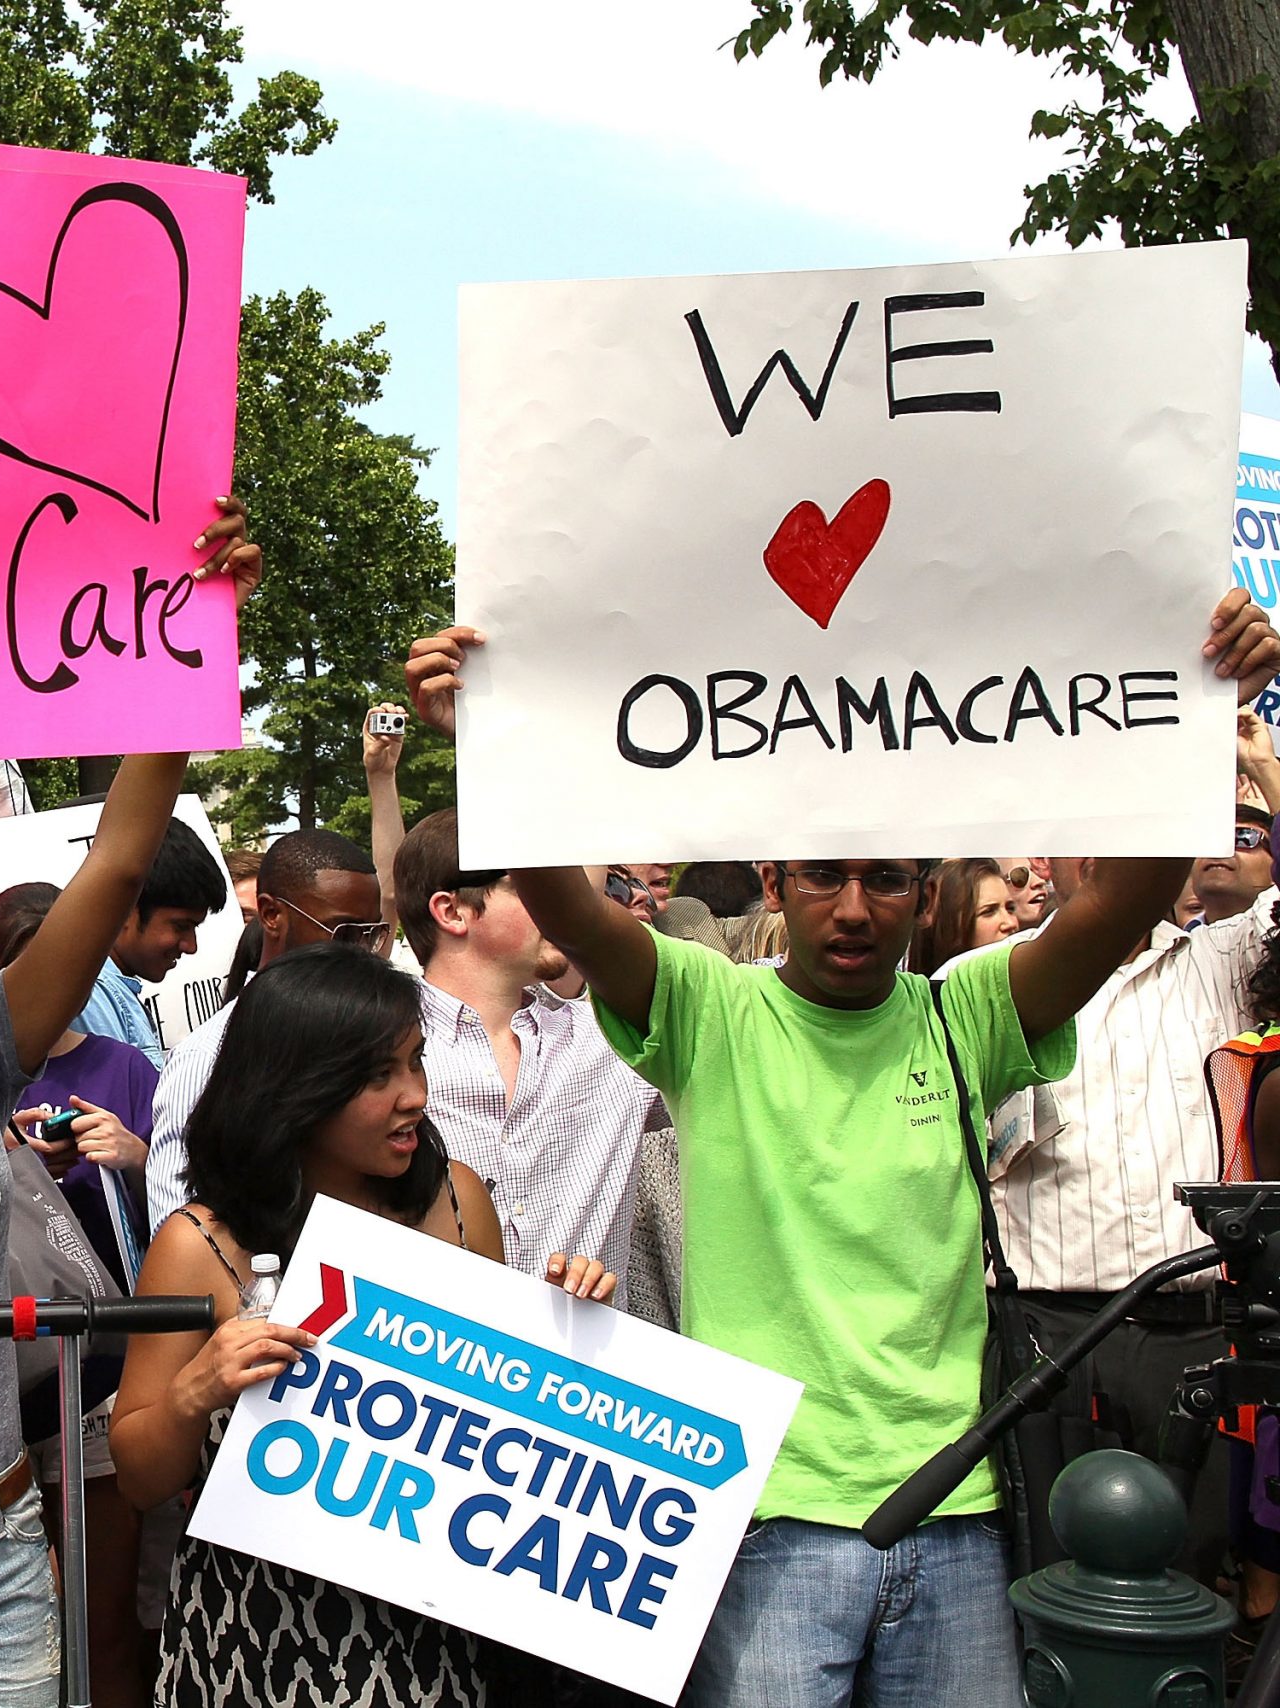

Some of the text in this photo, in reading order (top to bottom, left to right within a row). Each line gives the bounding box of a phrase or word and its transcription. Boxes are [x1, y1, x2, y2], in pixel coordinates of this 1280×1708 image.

[685, 291, 1001, 437] WE
[617, 665, 1180, 769] OBAMACARE
[184, 974, 230, 1032] COUR
[910, 1114, 941, 1127] DININ
[268, 1347, 696, 1548] PROTECTING
[364, 1306, 725, 1467] MOVING FORWARD
[246, 1419, 679, 1631] OUR CARE
